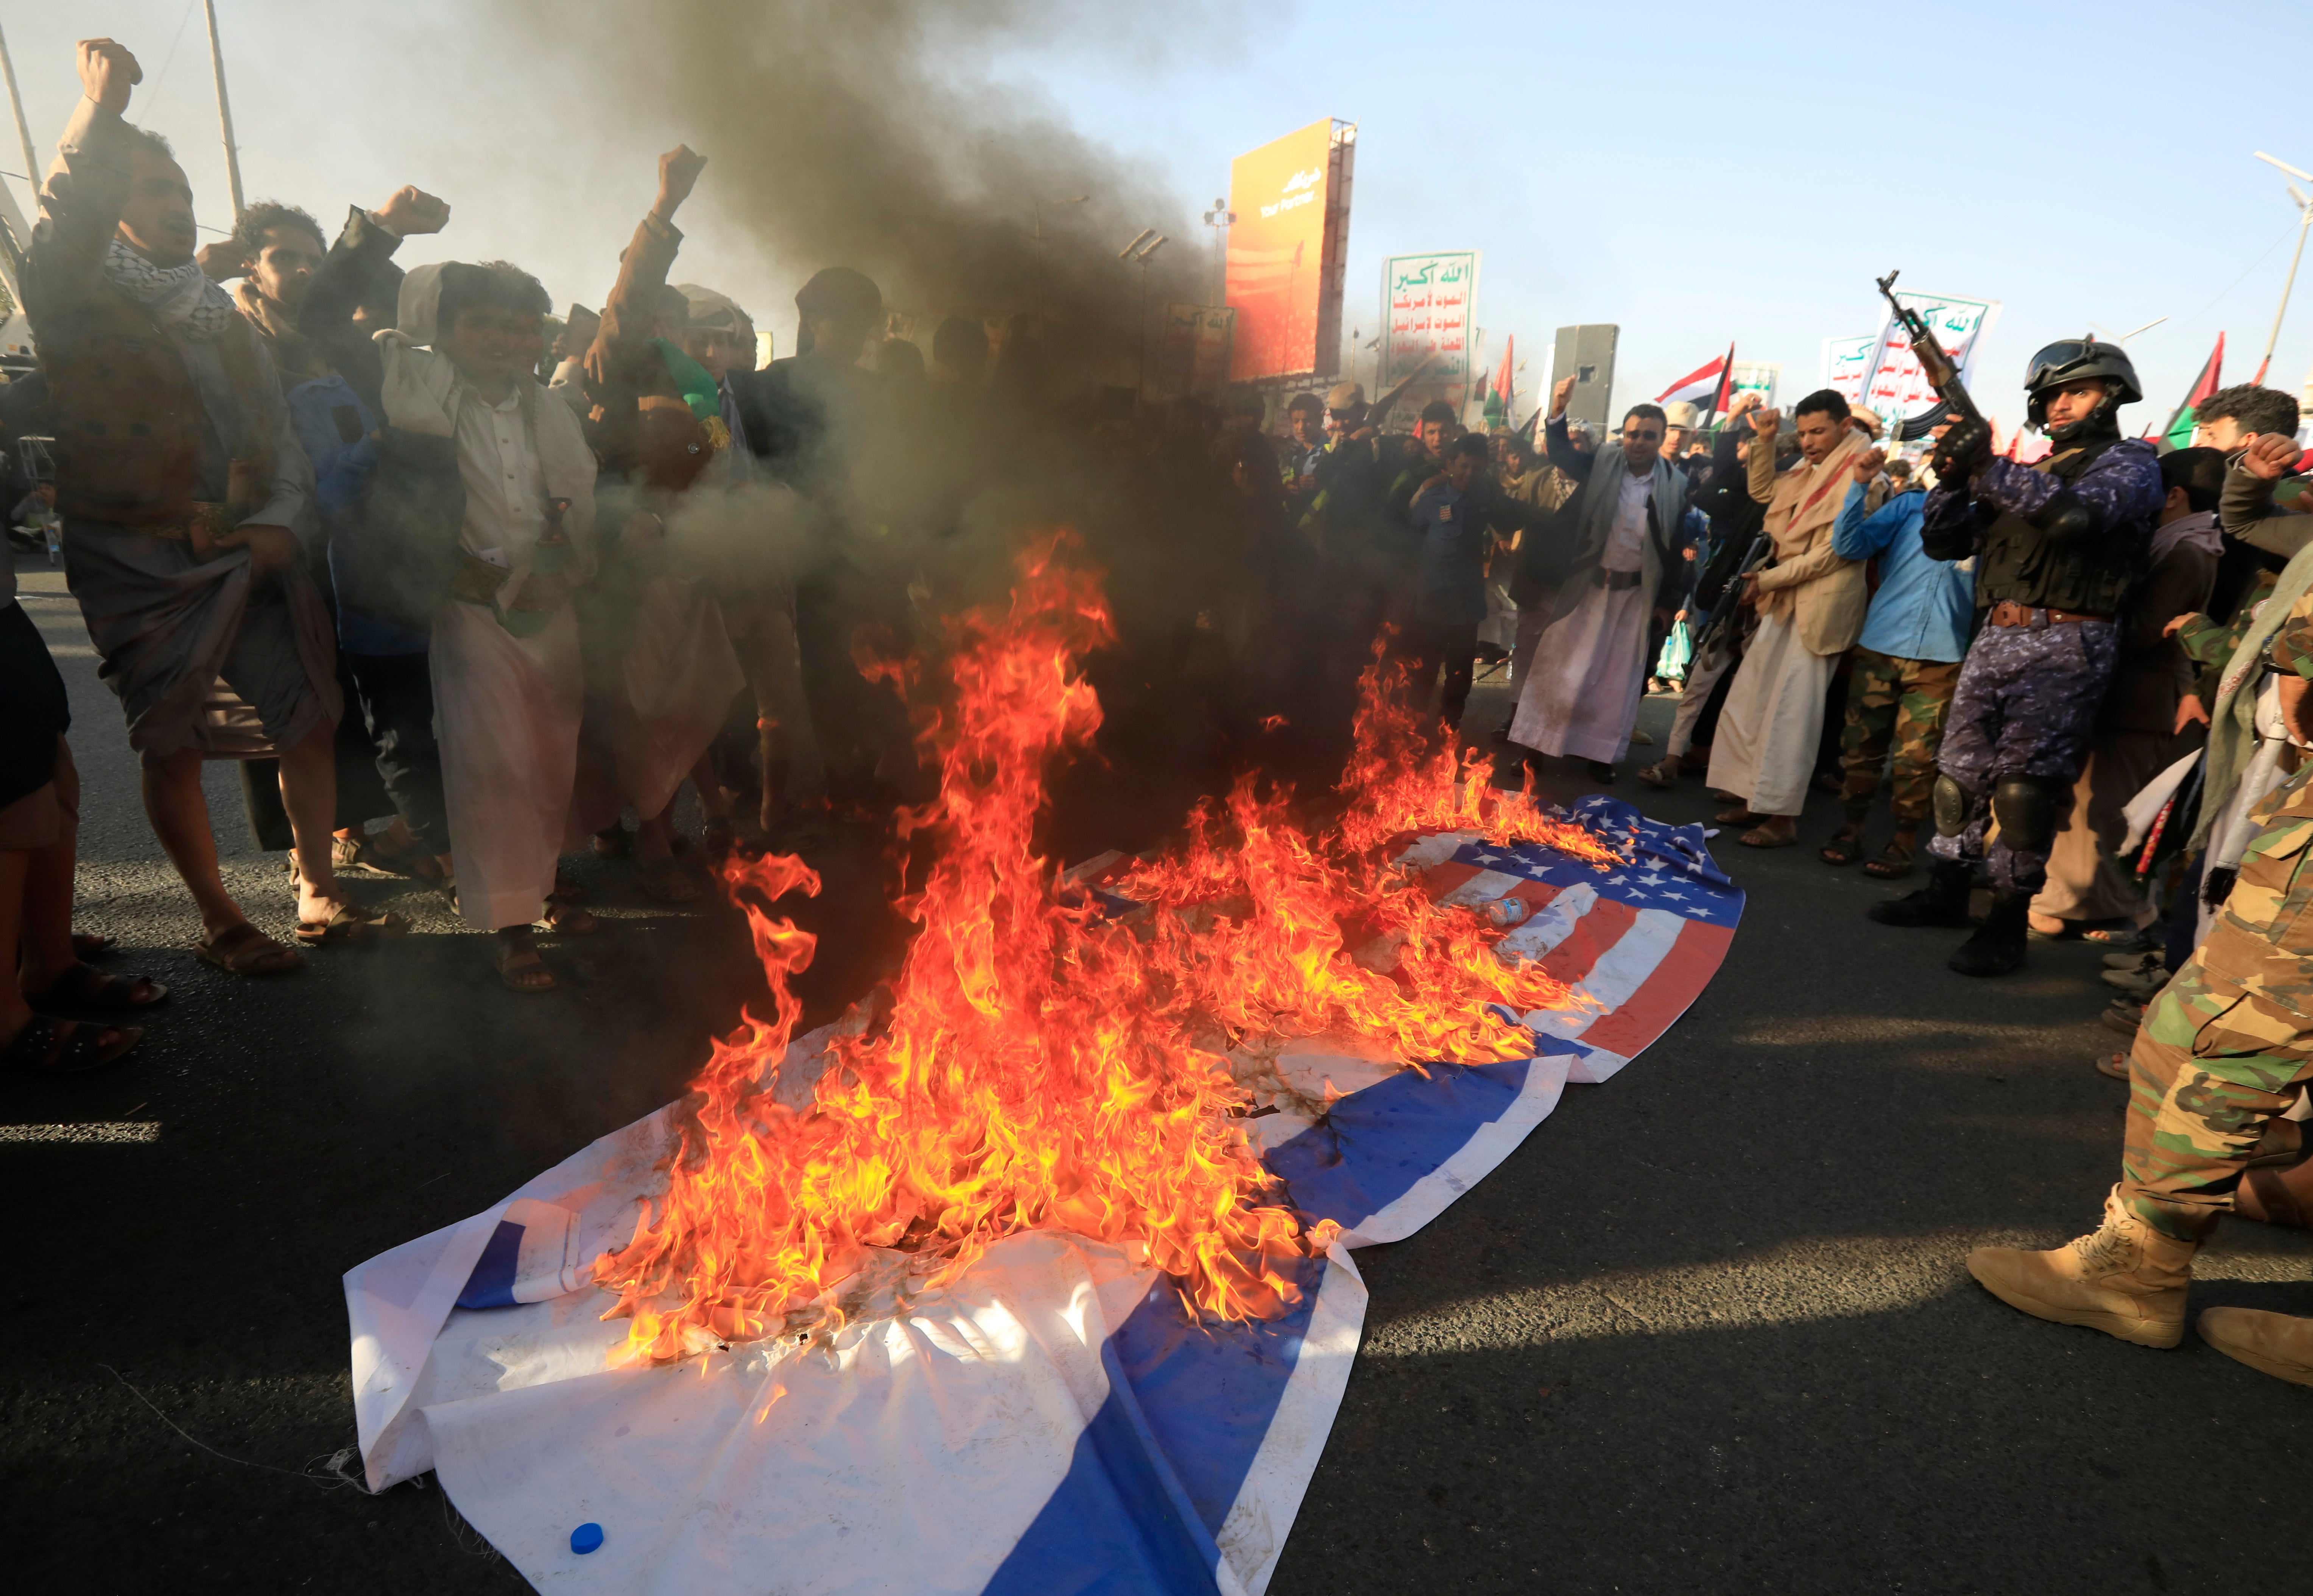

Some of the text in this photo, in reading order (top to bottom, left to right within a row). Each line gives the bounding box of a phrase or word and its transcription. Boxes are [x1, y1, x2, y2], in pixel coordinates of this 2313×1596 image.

[1394, 259, 1469, 292] الله أكبر
[1393, 290, 1466, 311] الموت لأمريكا
[1435, 314, 1465, 332] الموت
[1945, 310, 1981, 332] الله
